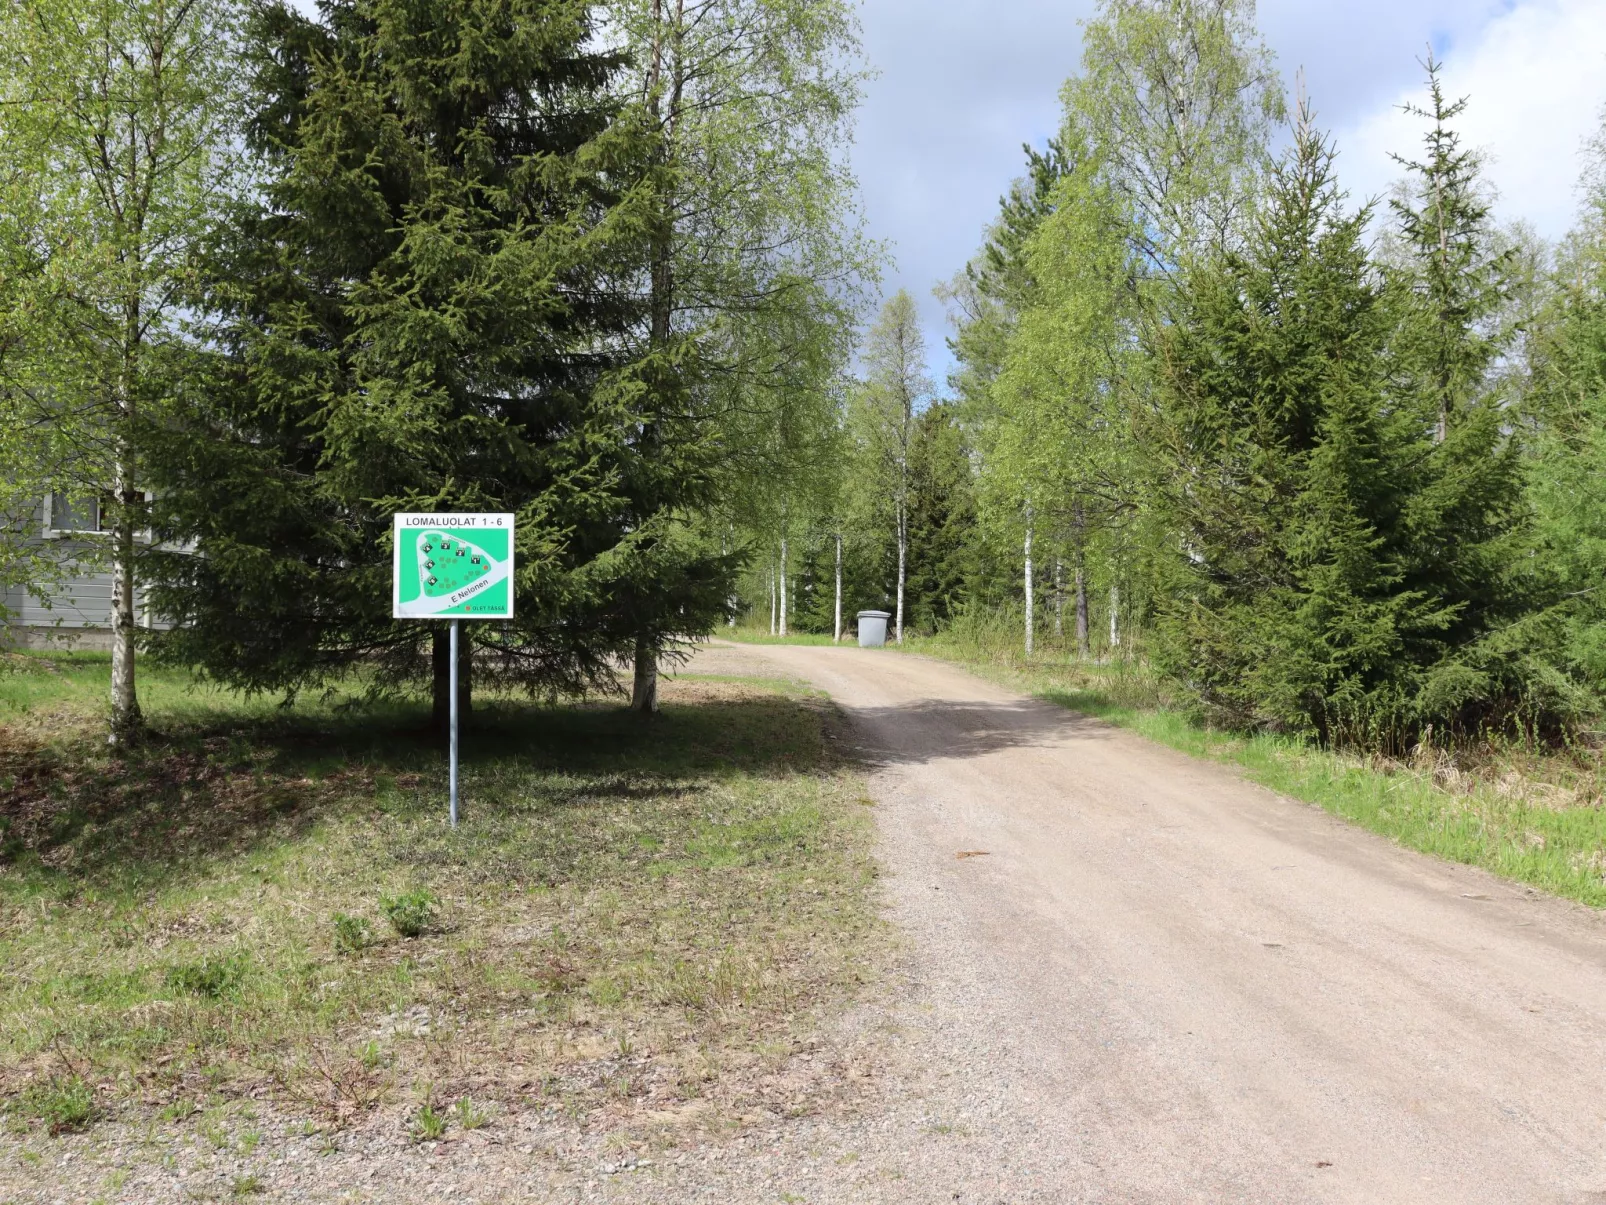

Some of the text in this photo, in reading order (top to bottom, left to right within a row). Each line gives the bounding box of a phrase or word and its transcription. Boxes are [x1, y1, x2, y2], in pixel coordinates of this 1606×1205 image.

[406, 517, 476, 526] LOMALUOLAT
[482, 517, 487, 526] 1
[496, 517, 503, 526] 6
[450, 579, 489, 603] E Nelonen
